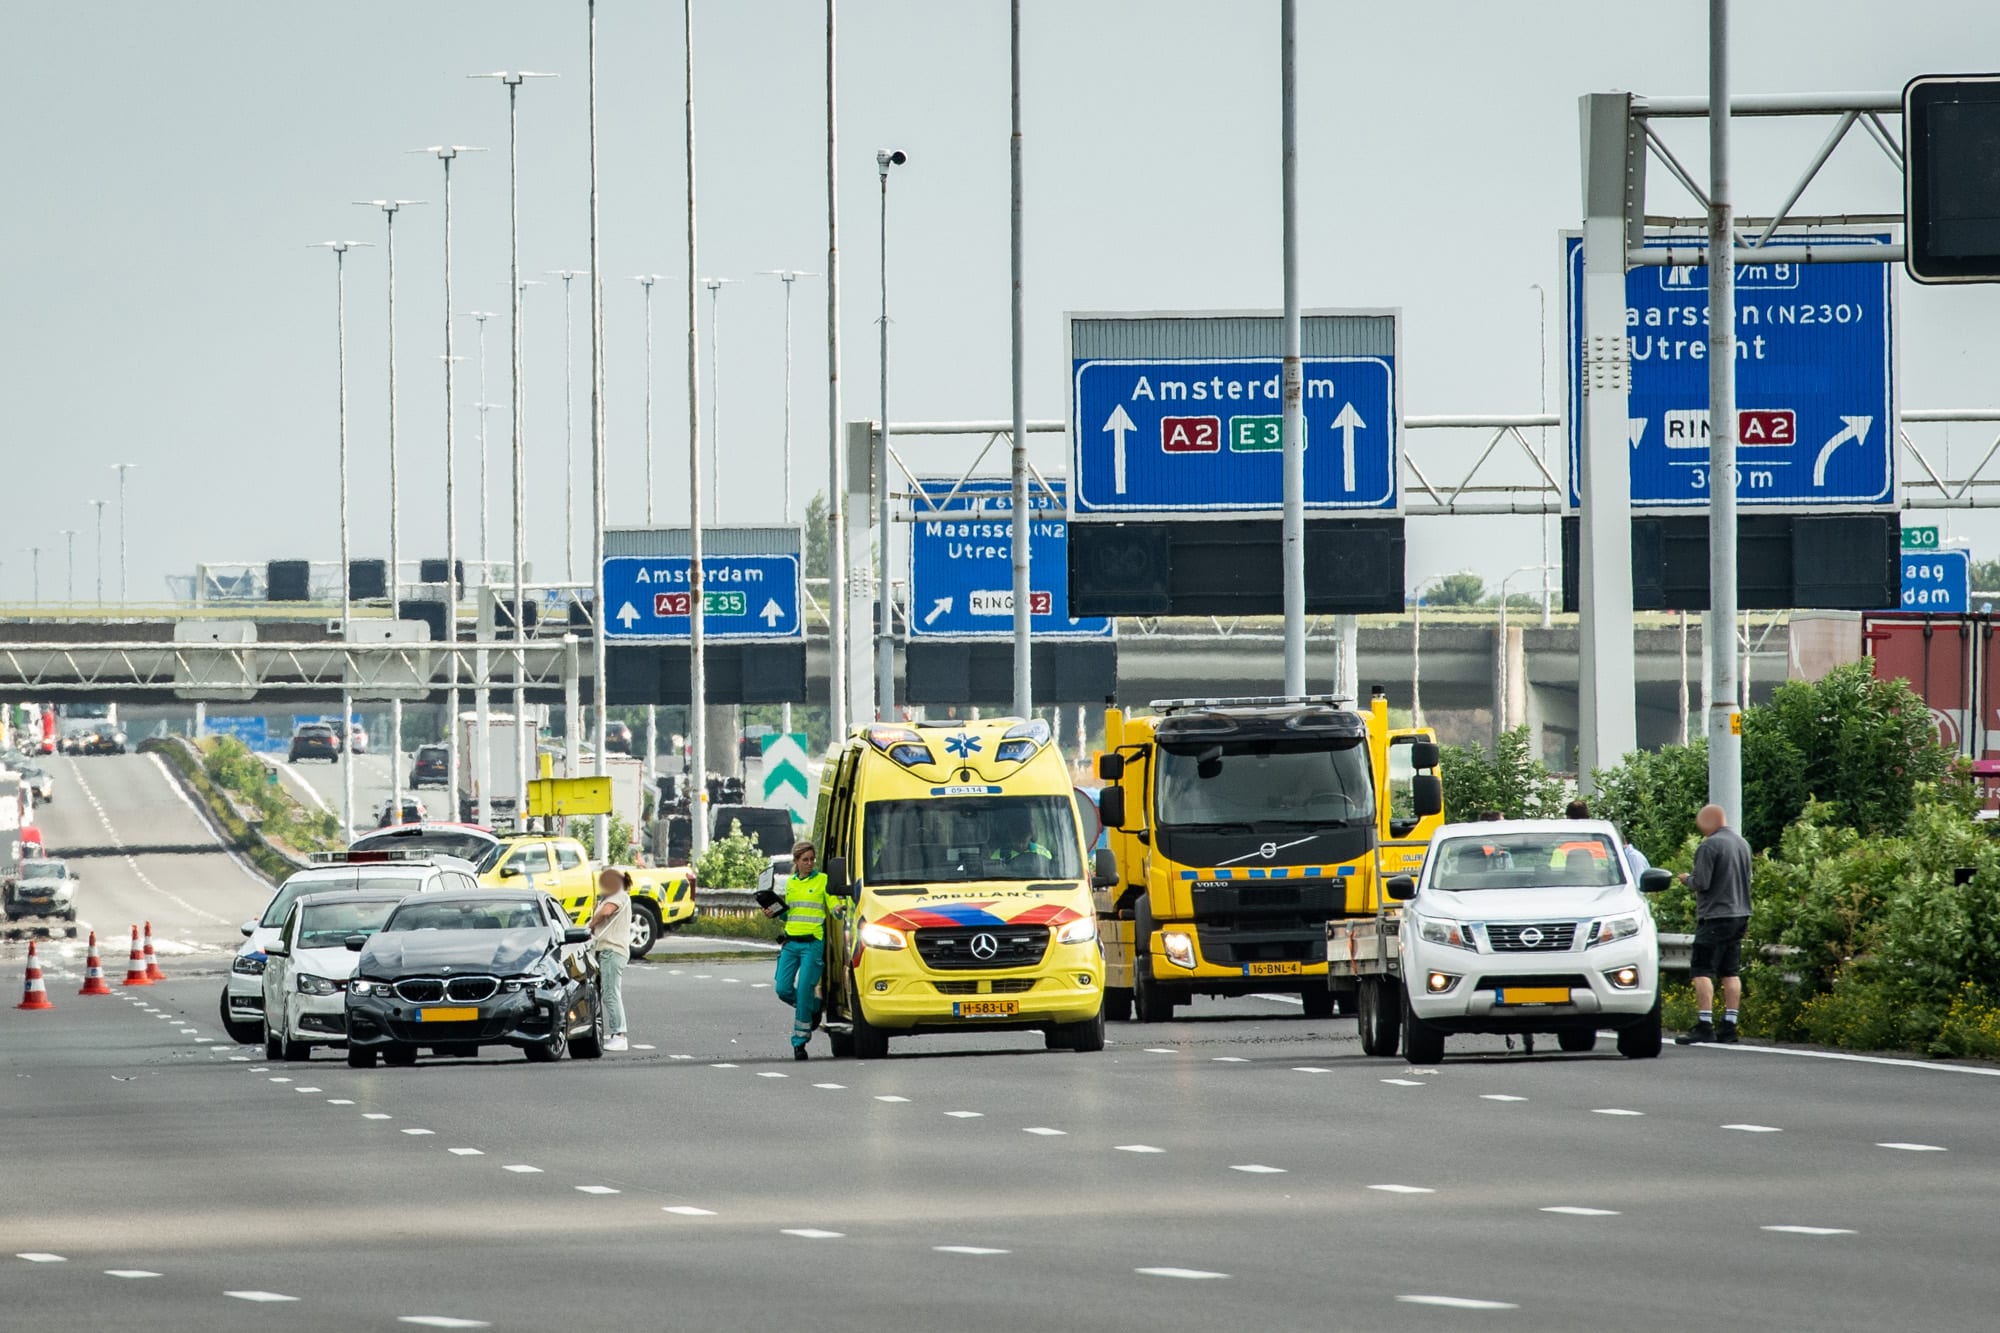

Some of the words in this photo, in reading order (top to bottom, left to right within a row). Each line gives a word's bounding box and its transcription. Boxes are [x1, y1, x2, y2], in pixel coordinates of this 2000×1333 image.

[1737, 264, 1768, 280] /m
[1775, 263, 1789, 280] 8
[1626, 305, 1759, 326] aarsn
[1767, 303, 1862, 325] (N230)
[1631, 335, 1766, 360] Utret
[1131, 375, 1335, 400] Amsterdm
[1239, 423, 1279, 445] E3
[1669, 420, 1711, 438] RIN
[1750, 471, 1773, 488] m
[926, 521, 1030, 538] Maarsse
[1034, 523, 1065, 538] (N2
[1901, 530, 1935, 545] 30
[948, 542, 1033, 559] Utrec
[1906, 564, 1944, 582] aag
[1903, 587, 1950, 605] dam
[916, 891, 1046, 902] AMBULANCE
[1253, 963, 1297, 975] 16-BNL-4
[963, 1003, 1015, 1014] H-583-LR
